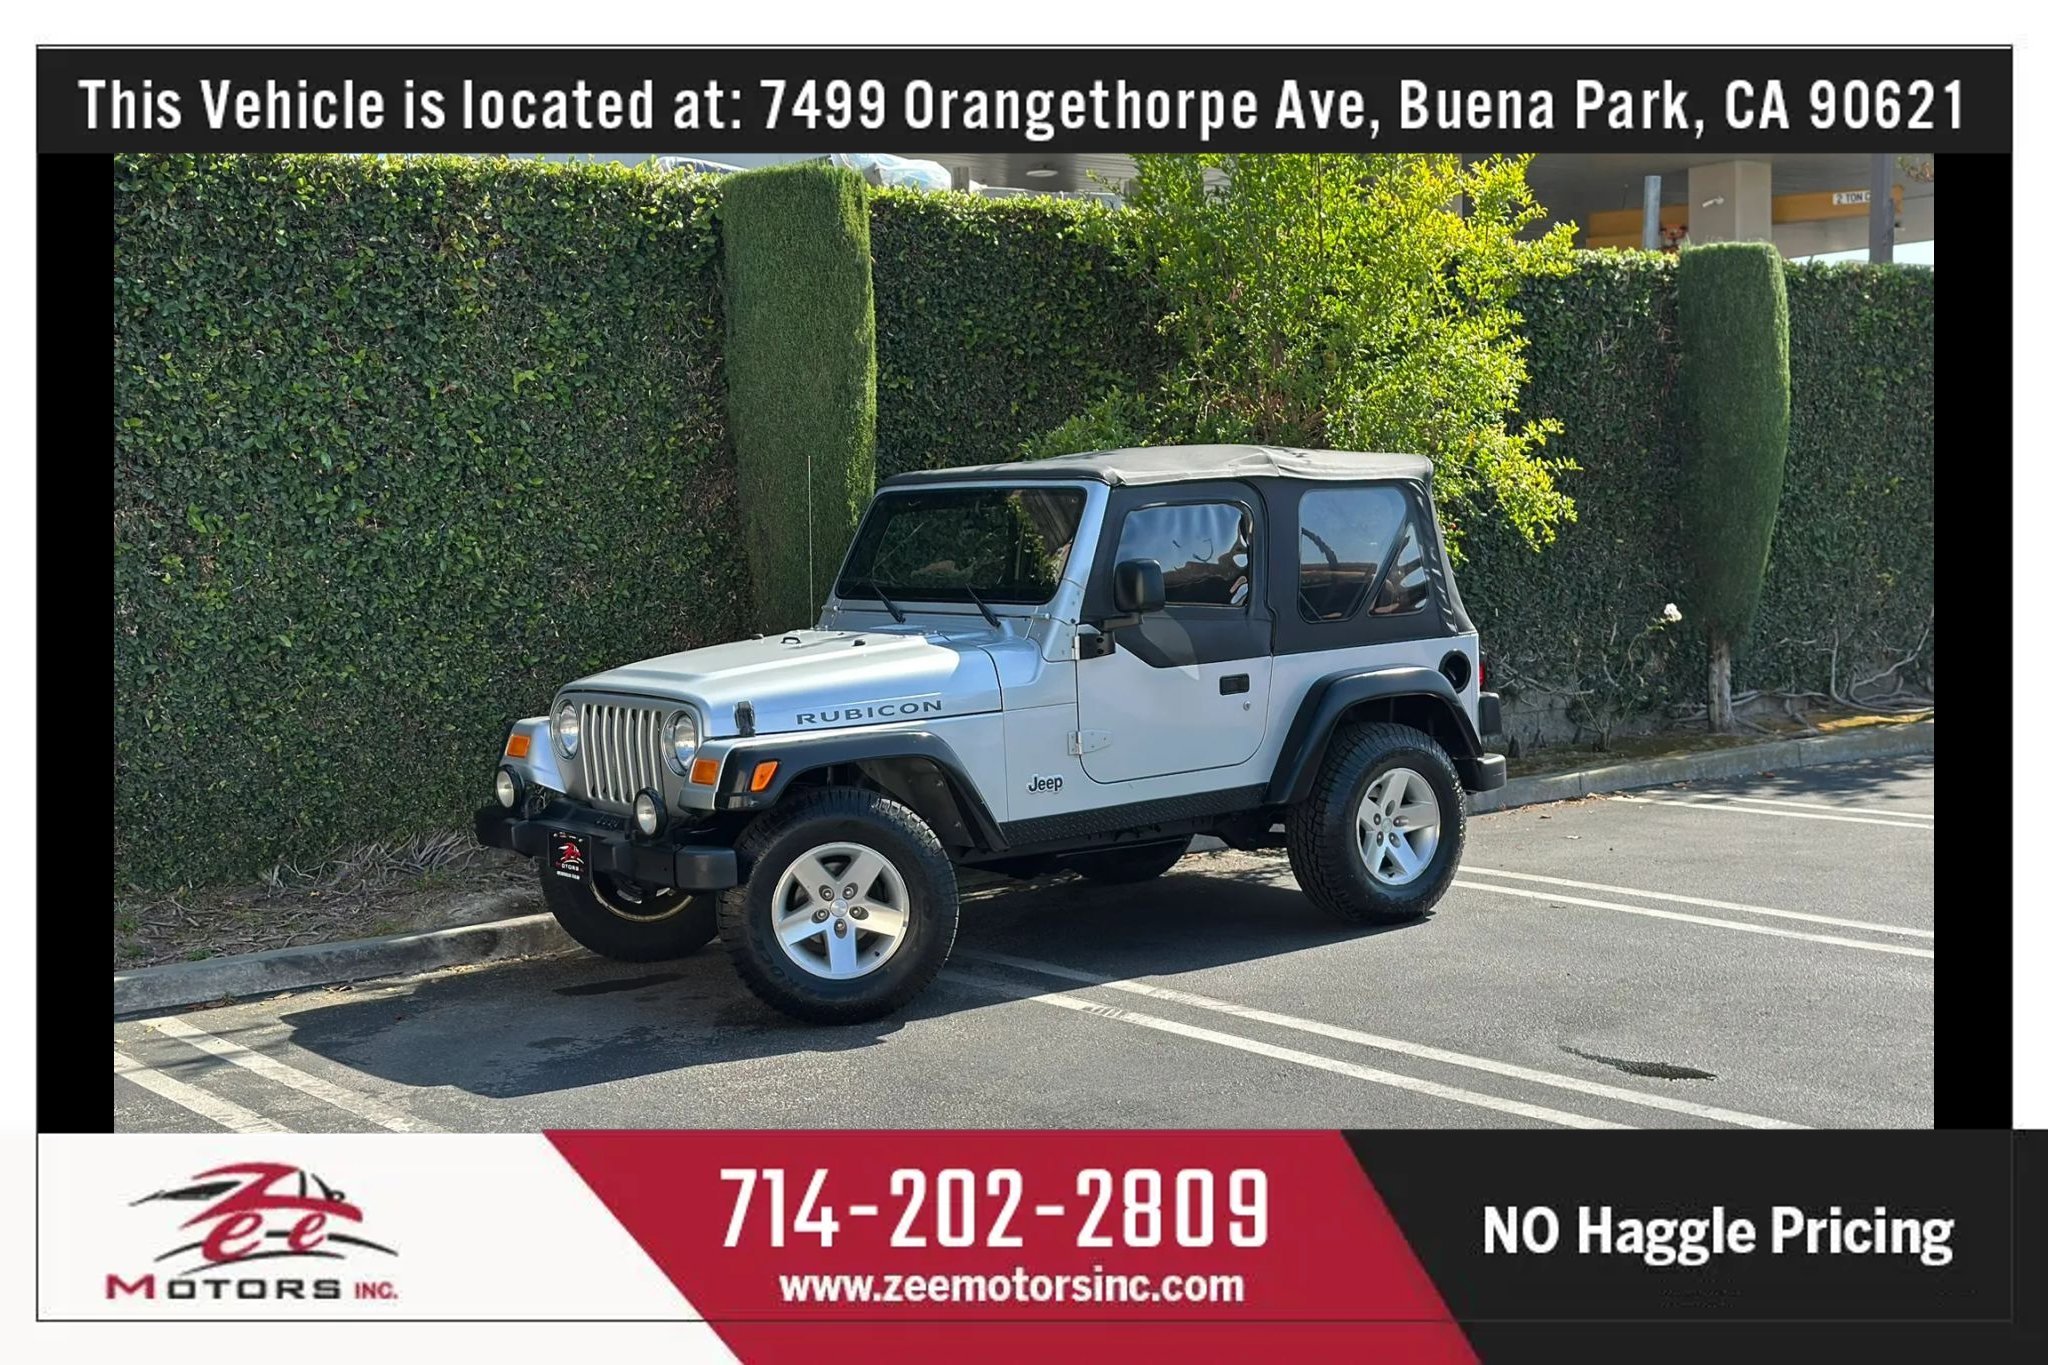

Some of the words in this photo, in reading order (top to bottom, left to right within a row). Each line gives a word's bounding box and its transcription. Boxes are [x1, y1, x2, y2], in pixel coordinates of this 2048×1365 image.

[1846, 192, 1863, 202] TON
[796, 700, 941, 724] RUBICON
[1028, 776, 1063, 792] Jeep
